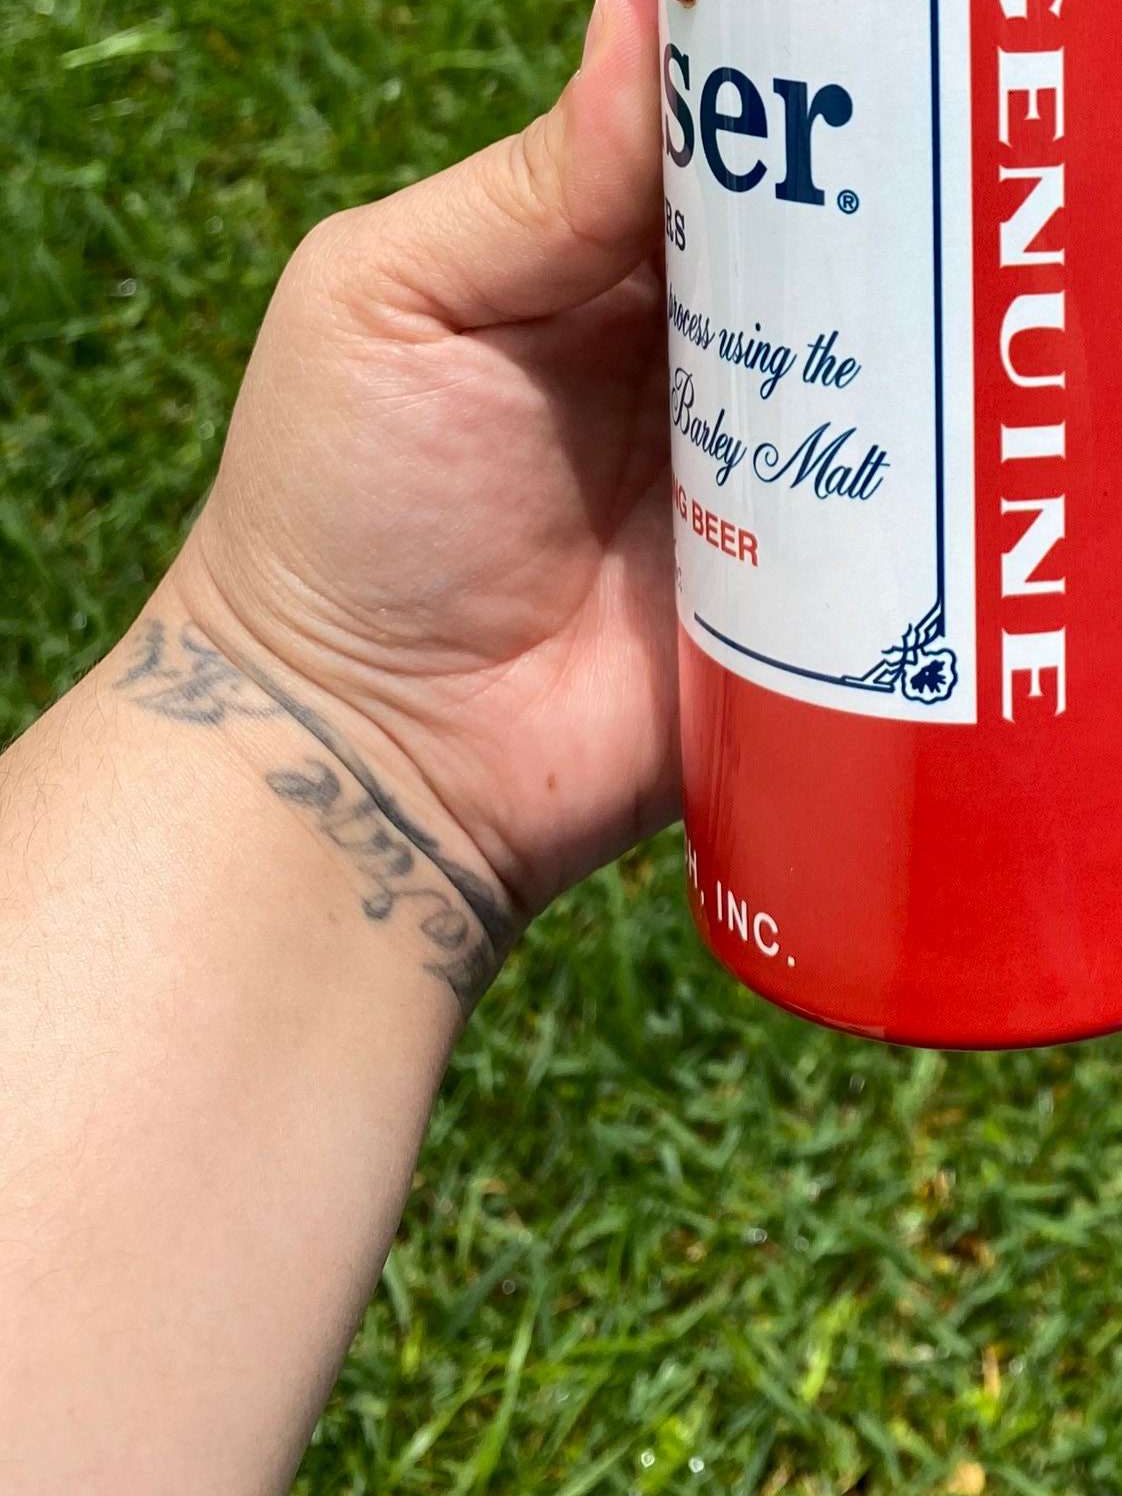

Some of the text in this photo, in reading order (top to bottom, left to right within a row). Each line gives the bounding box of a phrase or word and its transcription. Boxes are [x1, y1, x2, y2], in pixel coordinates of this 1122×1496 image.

[719, 322, 797, 400] using
[802, 330, 862, 389] the
[671, 367, 891, 501] Barley Malt
[692, 498, 759, 567] BEER
[717, 879, 796, 967] INC.
